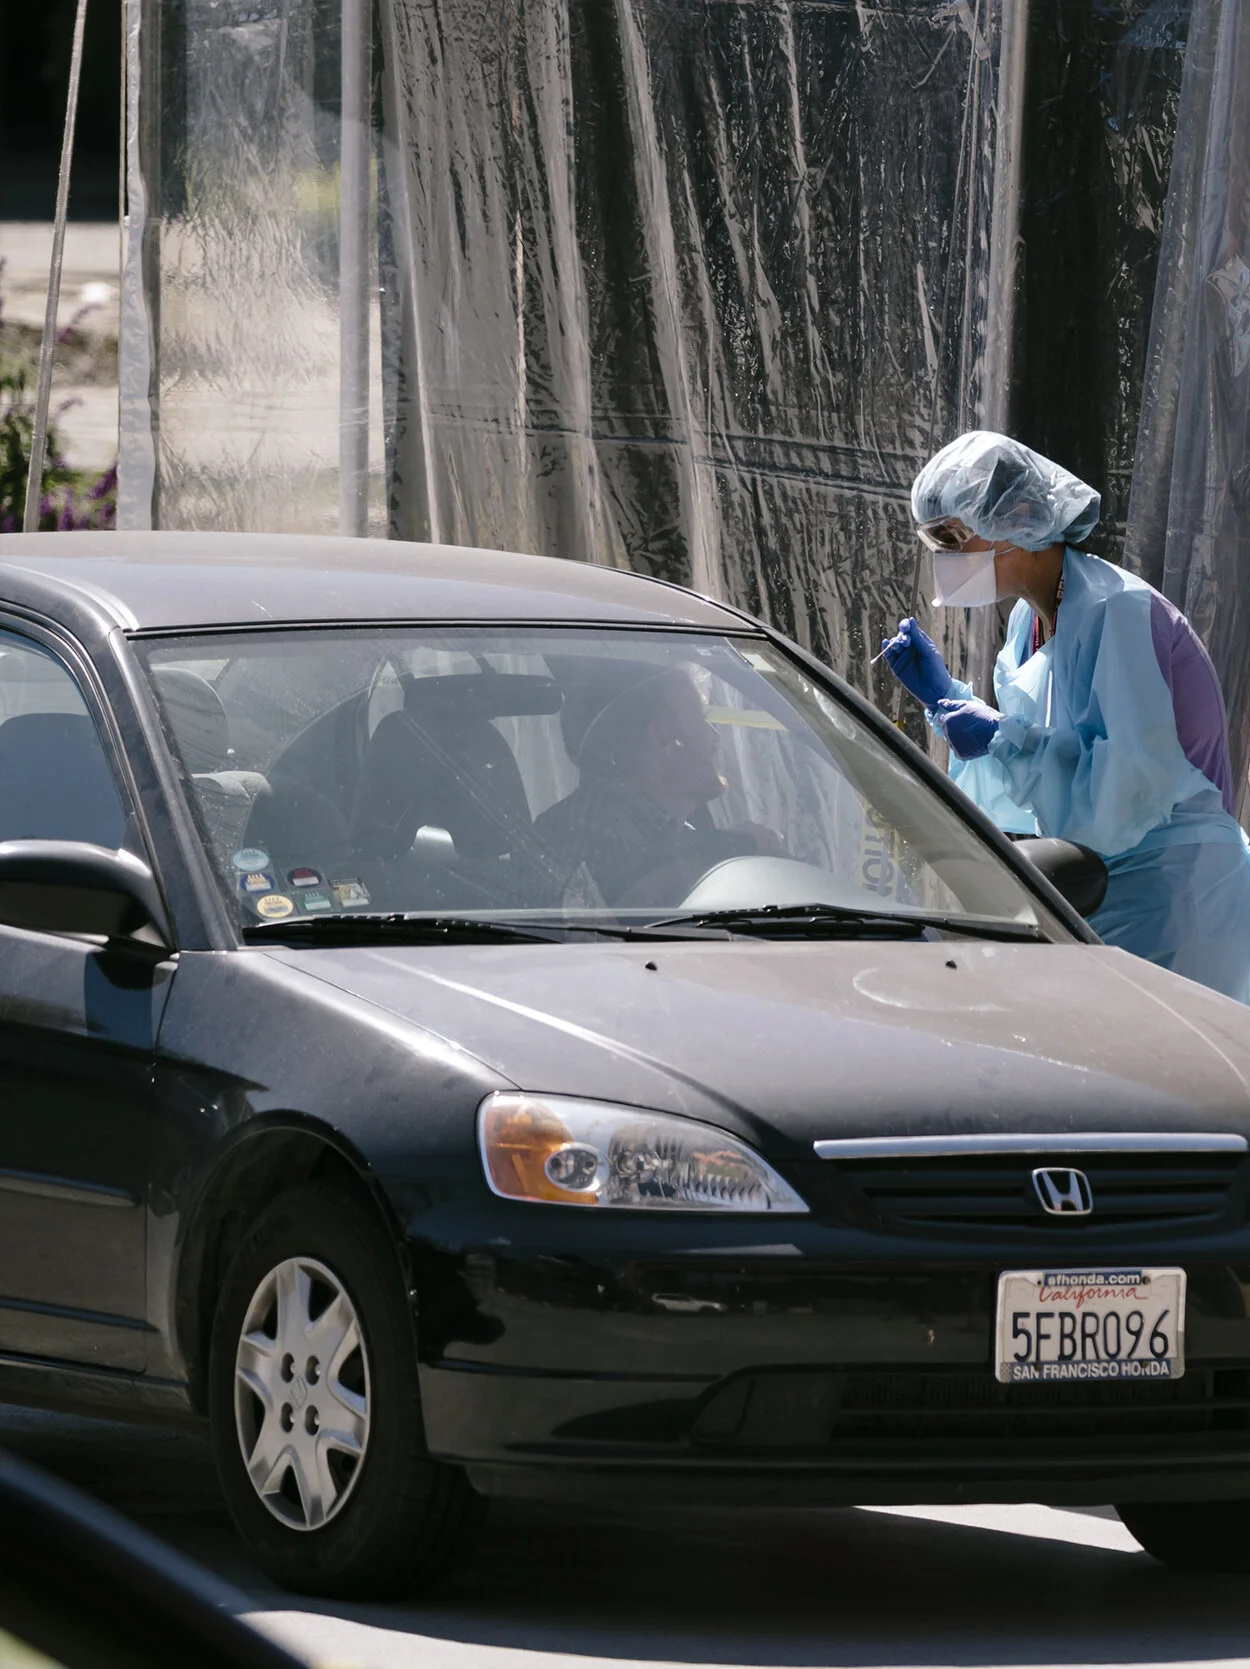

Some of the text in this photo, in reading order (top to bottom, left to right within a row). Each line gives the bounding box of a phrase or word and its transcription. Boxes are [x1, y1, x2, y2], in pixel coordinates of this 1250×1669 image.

[1039, 1285, 1150, 1309] California
[1012, 1309, 1170, 1362] 5FBR096
[1013, 1362, 1170, 1380] SAN FRANCISCO HONDA
